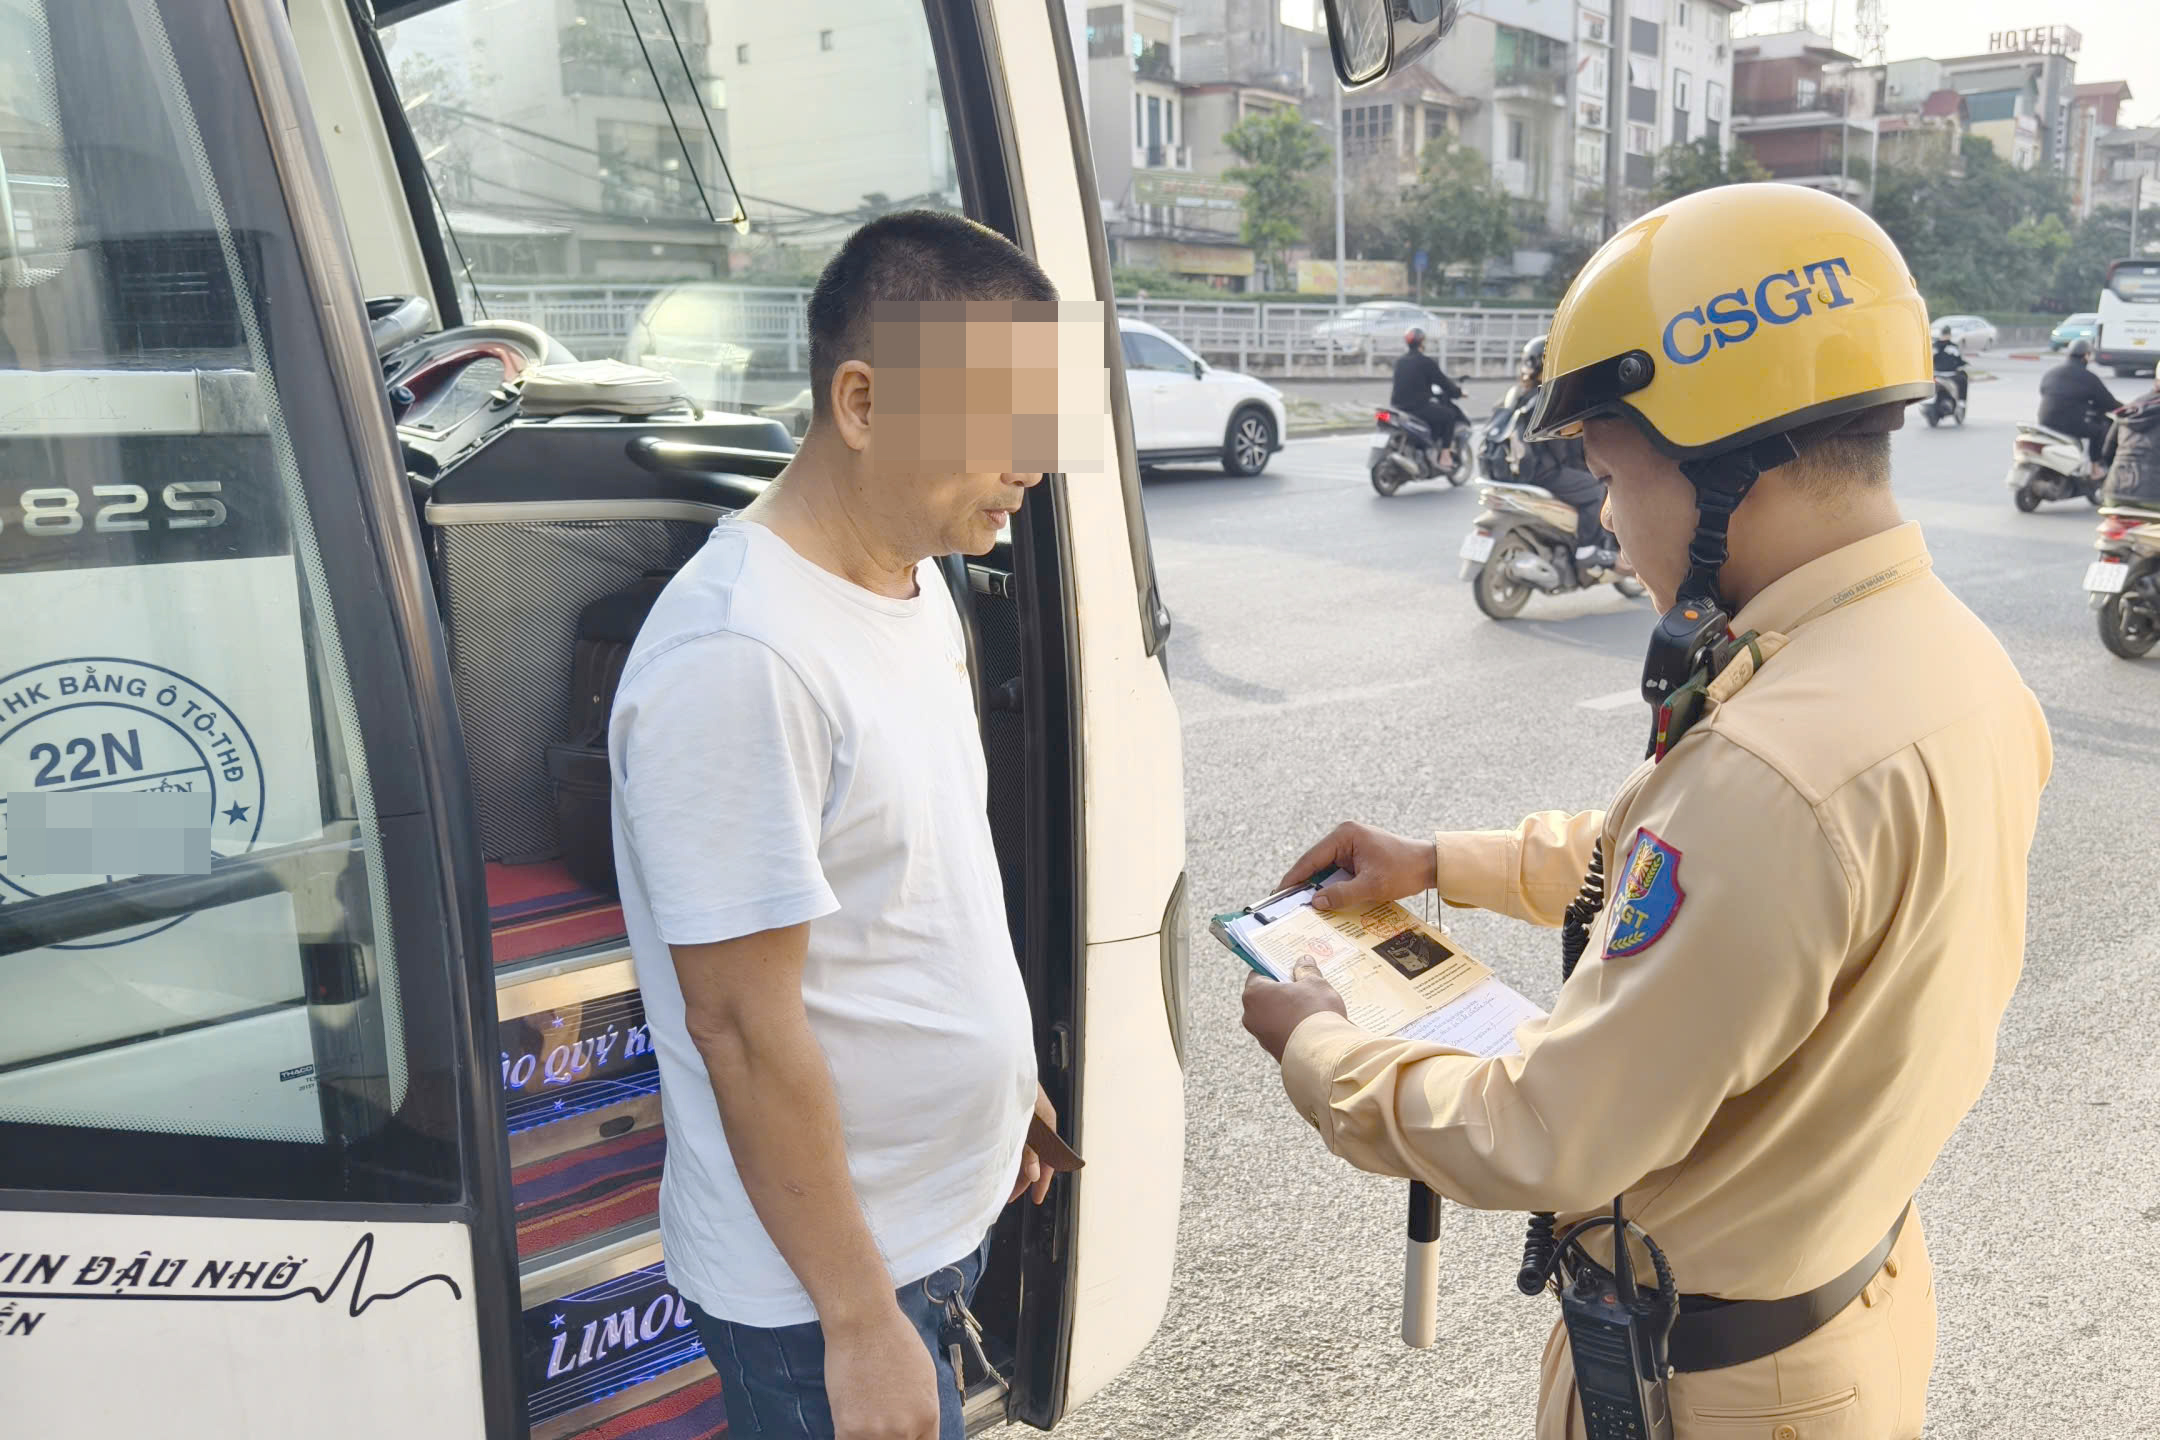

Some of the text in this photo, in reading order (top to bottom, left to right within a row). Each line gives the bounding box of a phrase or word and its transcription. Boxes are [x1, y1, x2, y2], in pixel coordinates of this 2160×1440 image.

[1990, 26, 2060, 51] HOTEL
[1662, 257, 1854, 365] CSGT
[0, 480, 227, 537] 82S
[58, 665, 148, 698] BẰNG
[156, 684, 177, 707] Ô
[181, 699, 244, 782] TÔ-THĐ
[29, 729, 144, 787] 22N
[281, 1065, 313, 1078] THACO
[543, 1024, 619, 1087] QUÝ
[624, 1023, 656, 1060] K
[72, 1250, 188, 1294] ĐẬU
[192, 1255, 309, 1289] NHỜ
